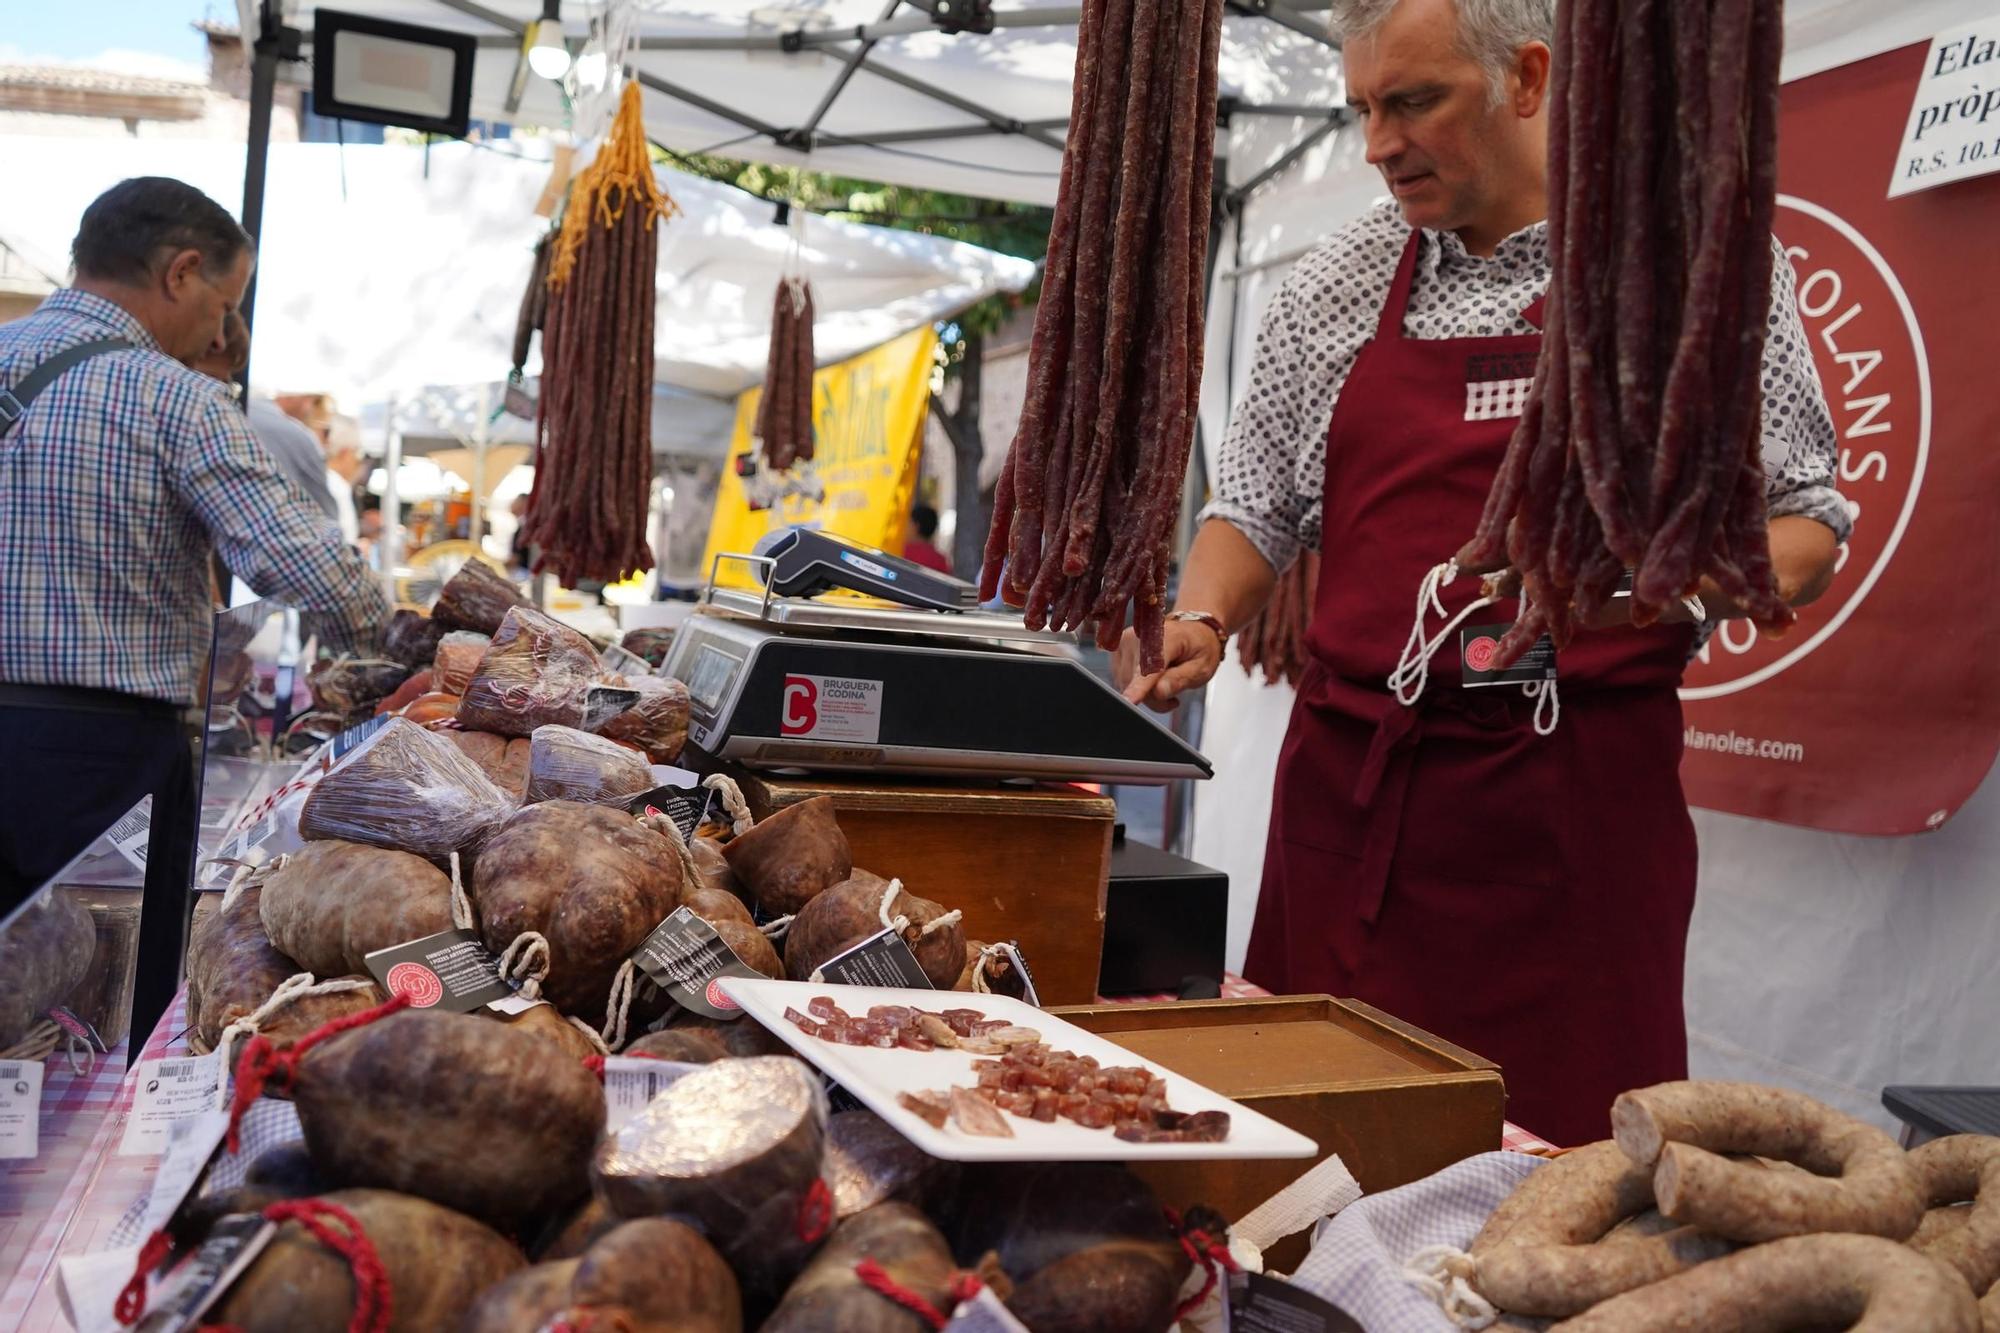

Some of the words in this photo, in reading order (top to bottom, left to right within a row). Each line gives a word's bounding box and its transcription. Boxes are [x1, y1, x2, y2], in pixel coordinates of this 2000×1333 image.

[1932, 35, 2000, 80] Ela
[1907, 150, 1947, 178] R.S.
[823, 679, 877, 692] BRUGUERA
[827, 689, 865, 700] CODINA
